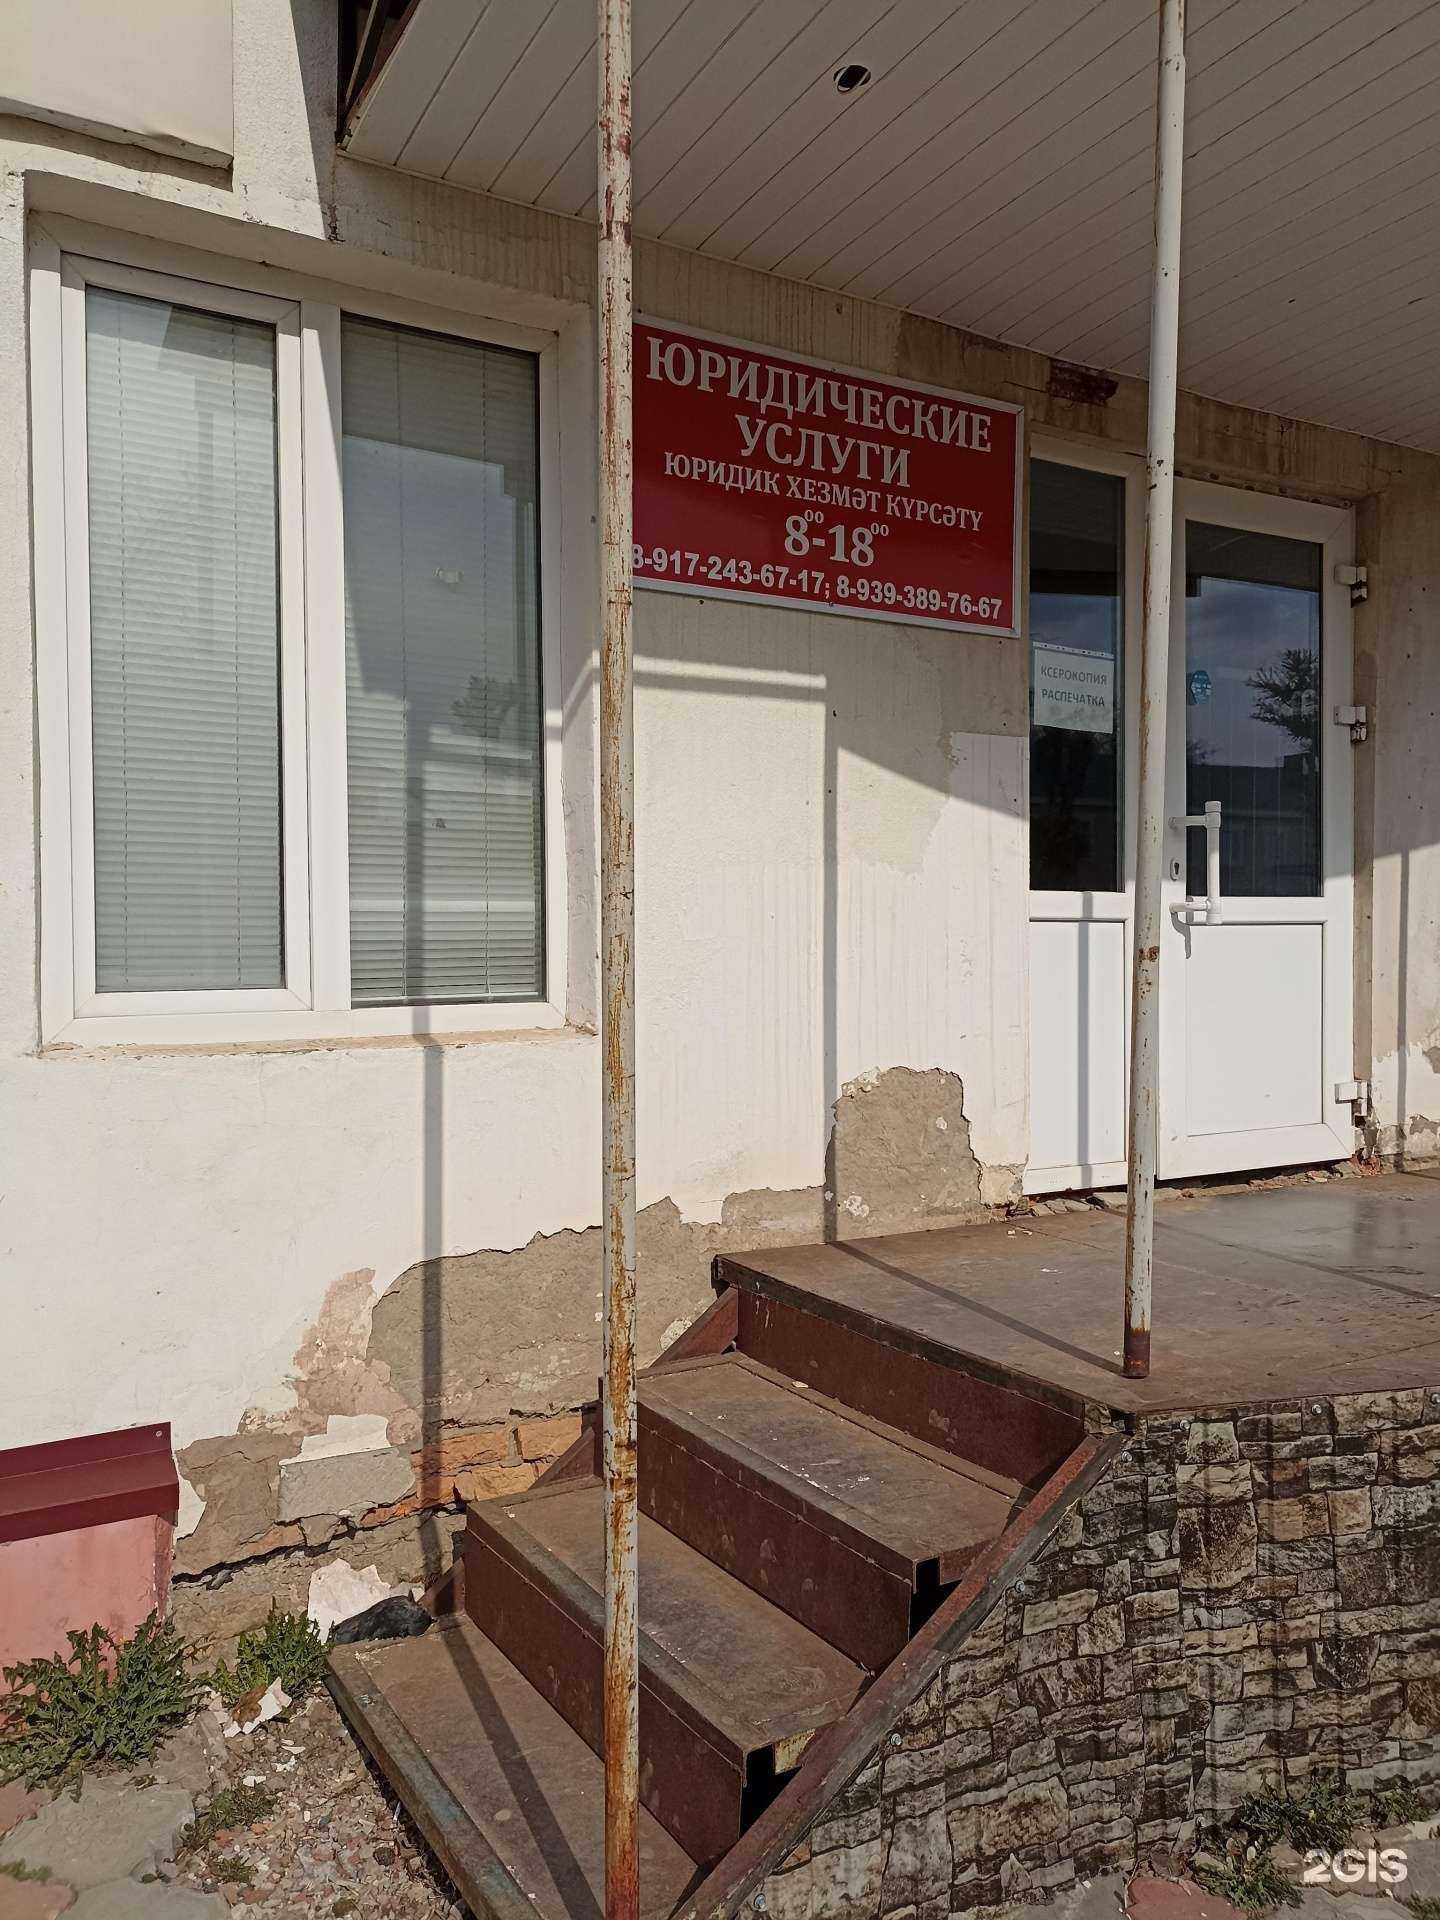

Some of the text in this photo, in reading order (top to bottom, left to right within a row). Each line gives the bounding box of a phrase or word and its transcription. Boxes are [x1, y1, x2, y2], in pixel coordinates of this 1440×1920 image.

[646, 336, 992, 453] ЮРИДИЧЕСКИЕ
[735, 414, 911, 488] УСЛУГИ
[664, 452, 781, 496] ЮРИДИК
[786, 475, 880, 513] ХЕЗМӘТ
[836, 575, 1003, 620] 8-939-389-76-67
[1040, 665, 1108, 685] КСЕРОКОПИЯ
[1041, 688, 1105, 707] РАСПЕЧАТКА
